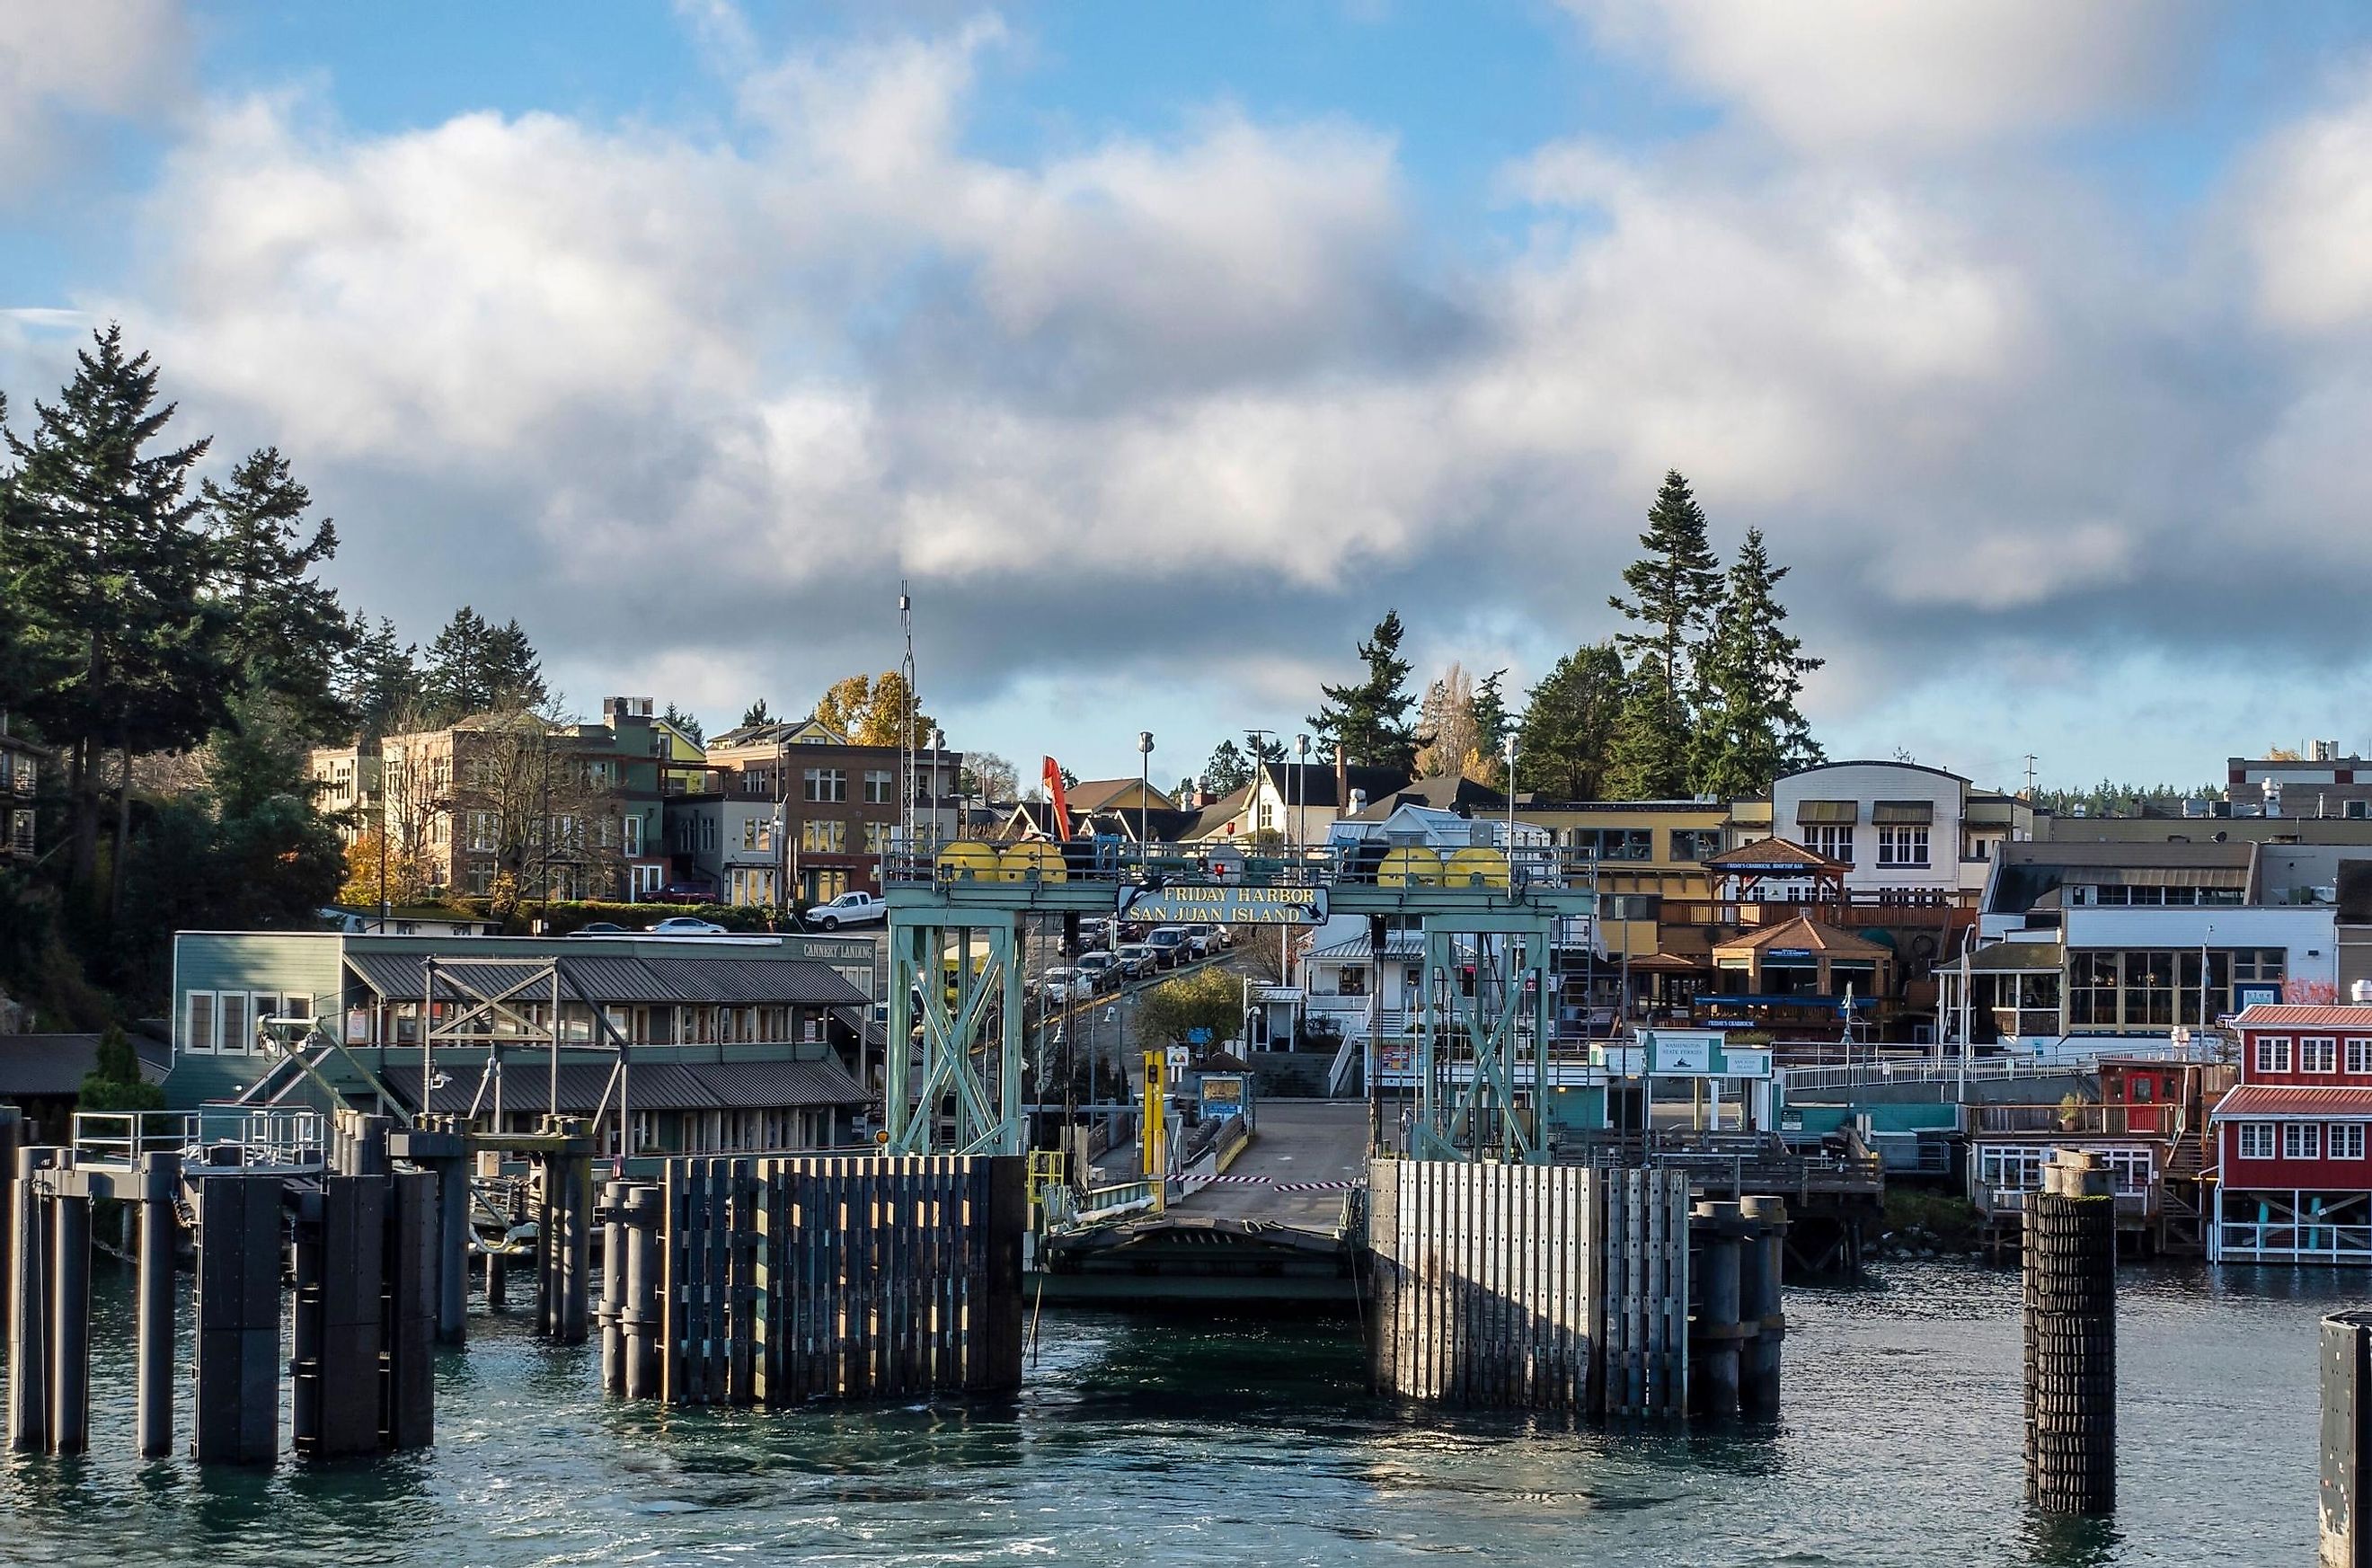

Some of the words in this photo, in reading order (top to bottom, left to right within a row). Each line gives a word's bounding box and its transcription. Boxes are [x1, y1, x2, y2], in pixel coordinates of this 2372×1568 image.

[1164, 887, 1228, 903] FRIDAY
[1237, 888, 1315, 903] HARBOR
[1129, 906, 1167, 921] SAN
[1173, 907, 1223, 922] JUAN
[1231, 908, 1300, 923] ISLAND
[803, 943, 839, 958] CANNERY
[840, 945, 872, 959] LANDING
